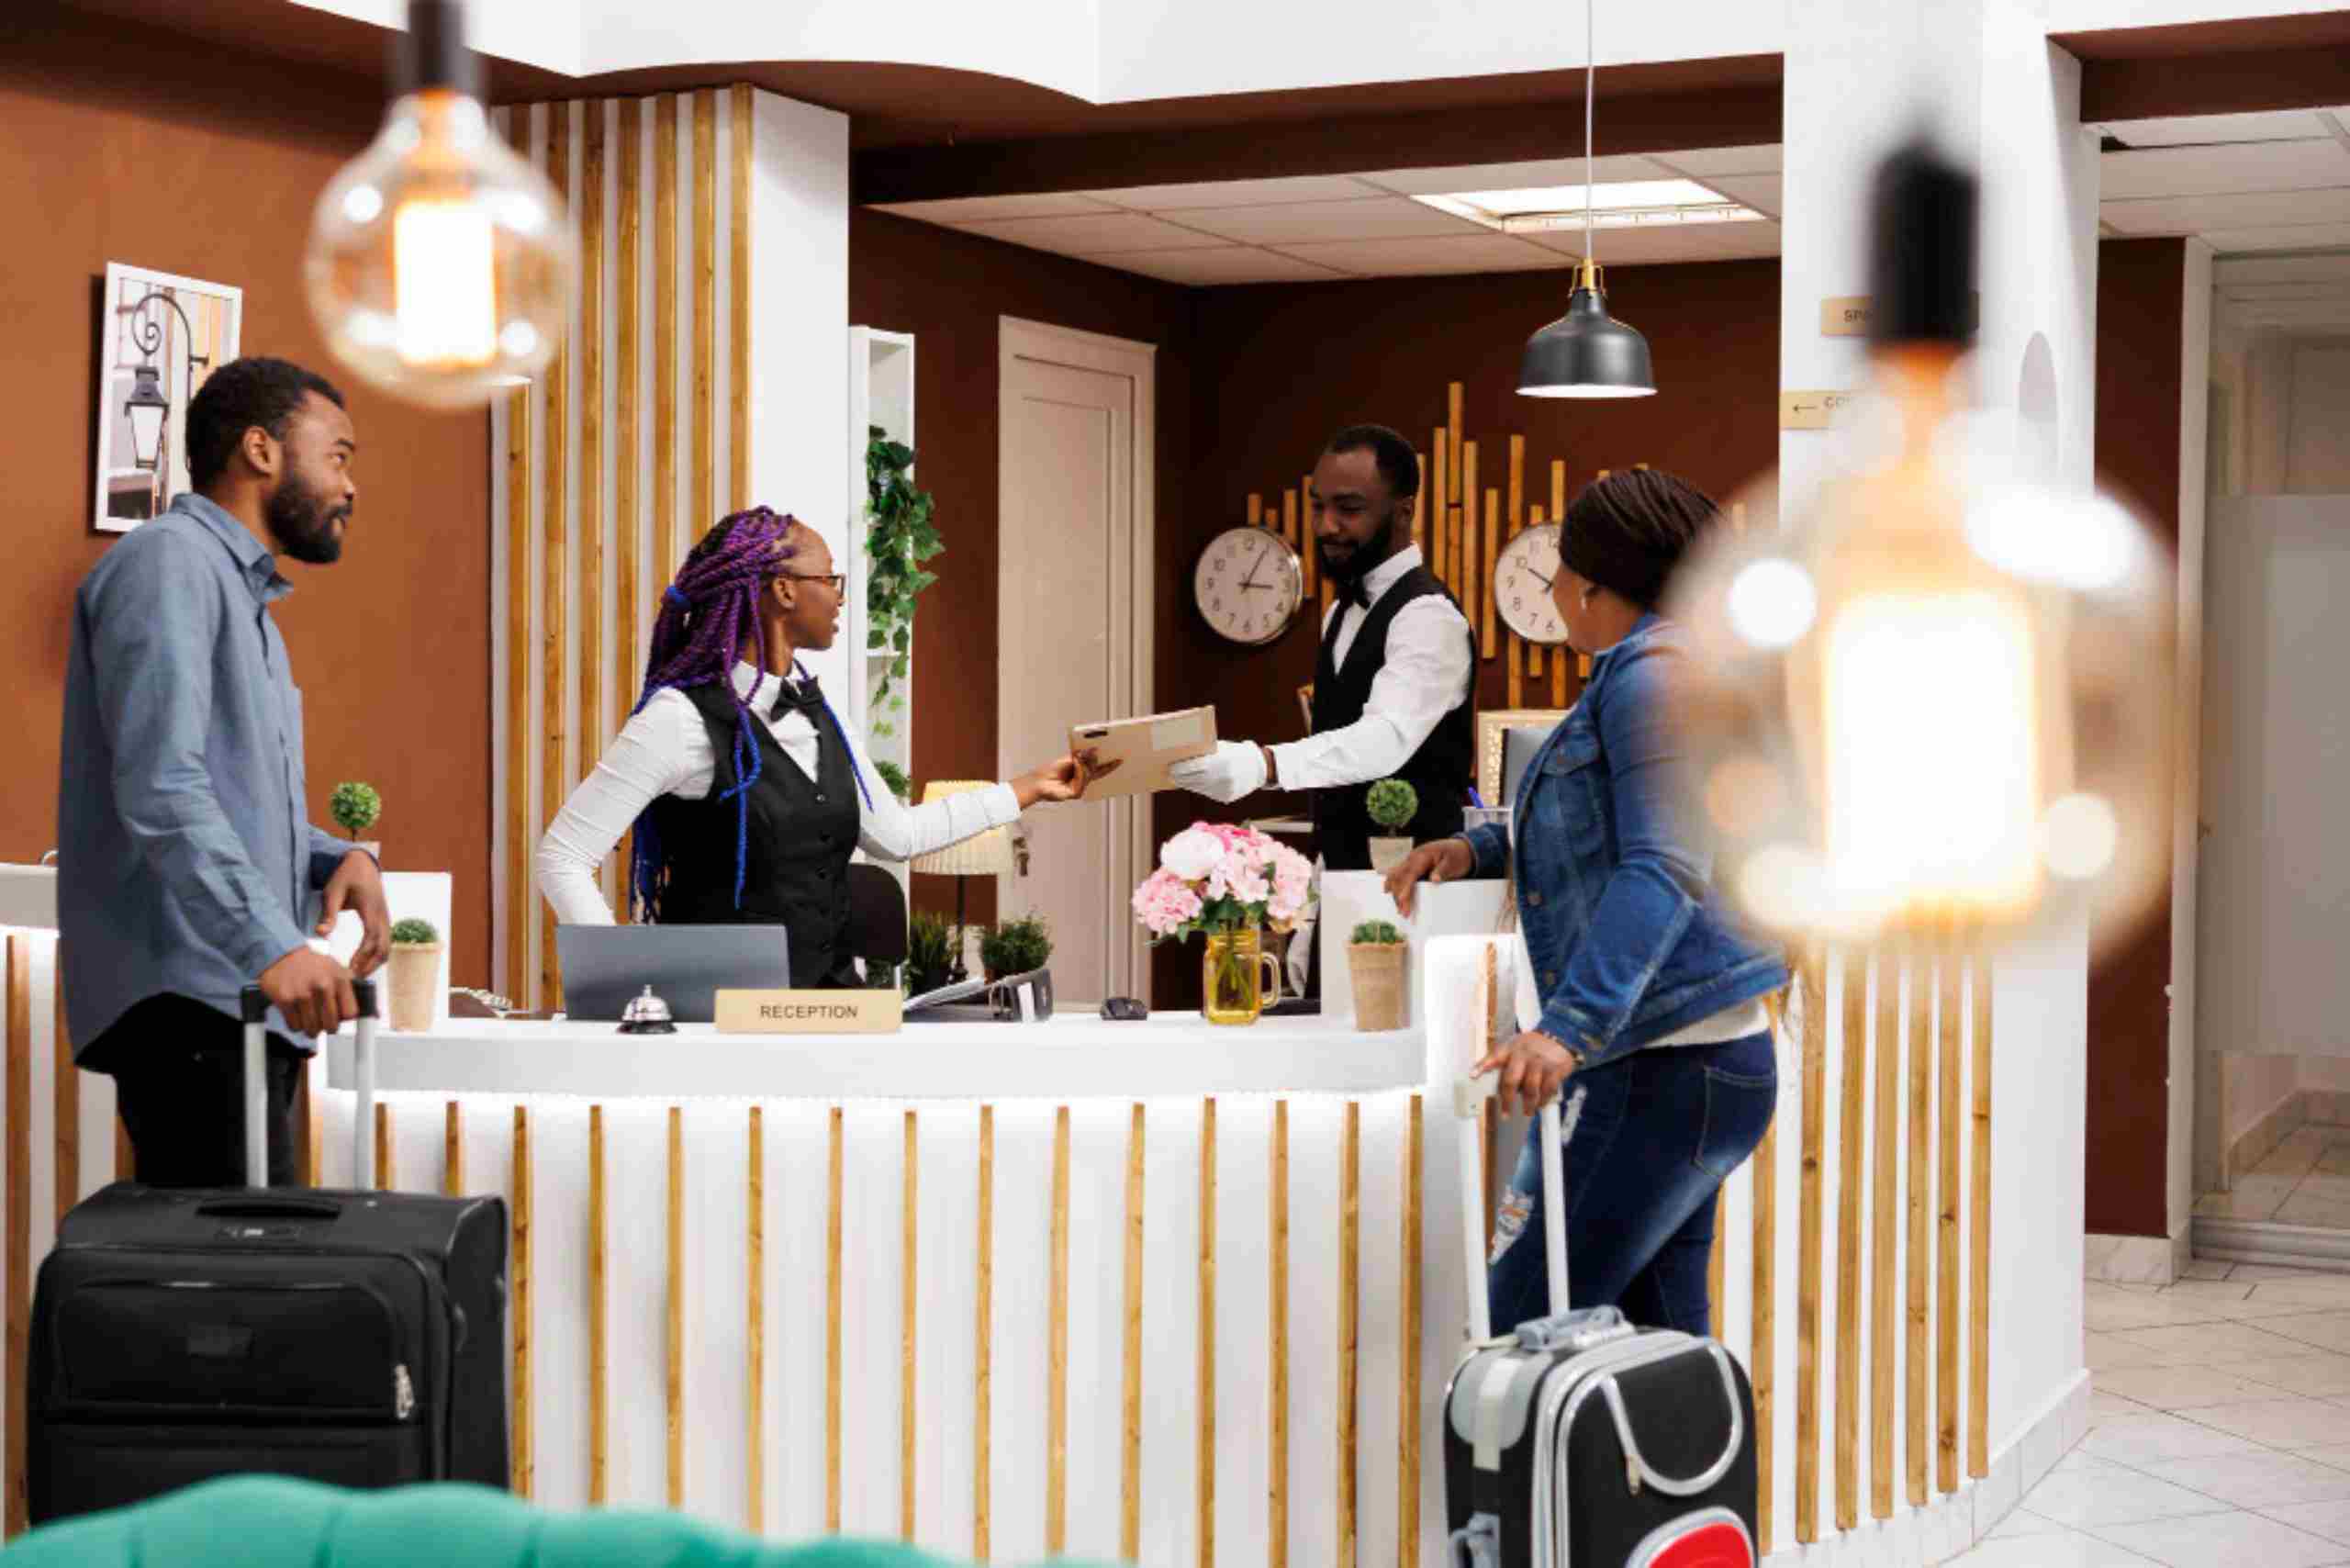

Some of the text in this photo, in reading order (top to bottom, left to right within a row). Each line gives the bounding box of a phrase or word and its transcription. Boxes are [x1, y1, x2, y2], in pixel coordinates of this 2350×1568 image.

[1528, 612, 1539, 627] 7
[1545, 619, 1555, 633] 6
[760, 1005, 858, 1019] RECEPTION
